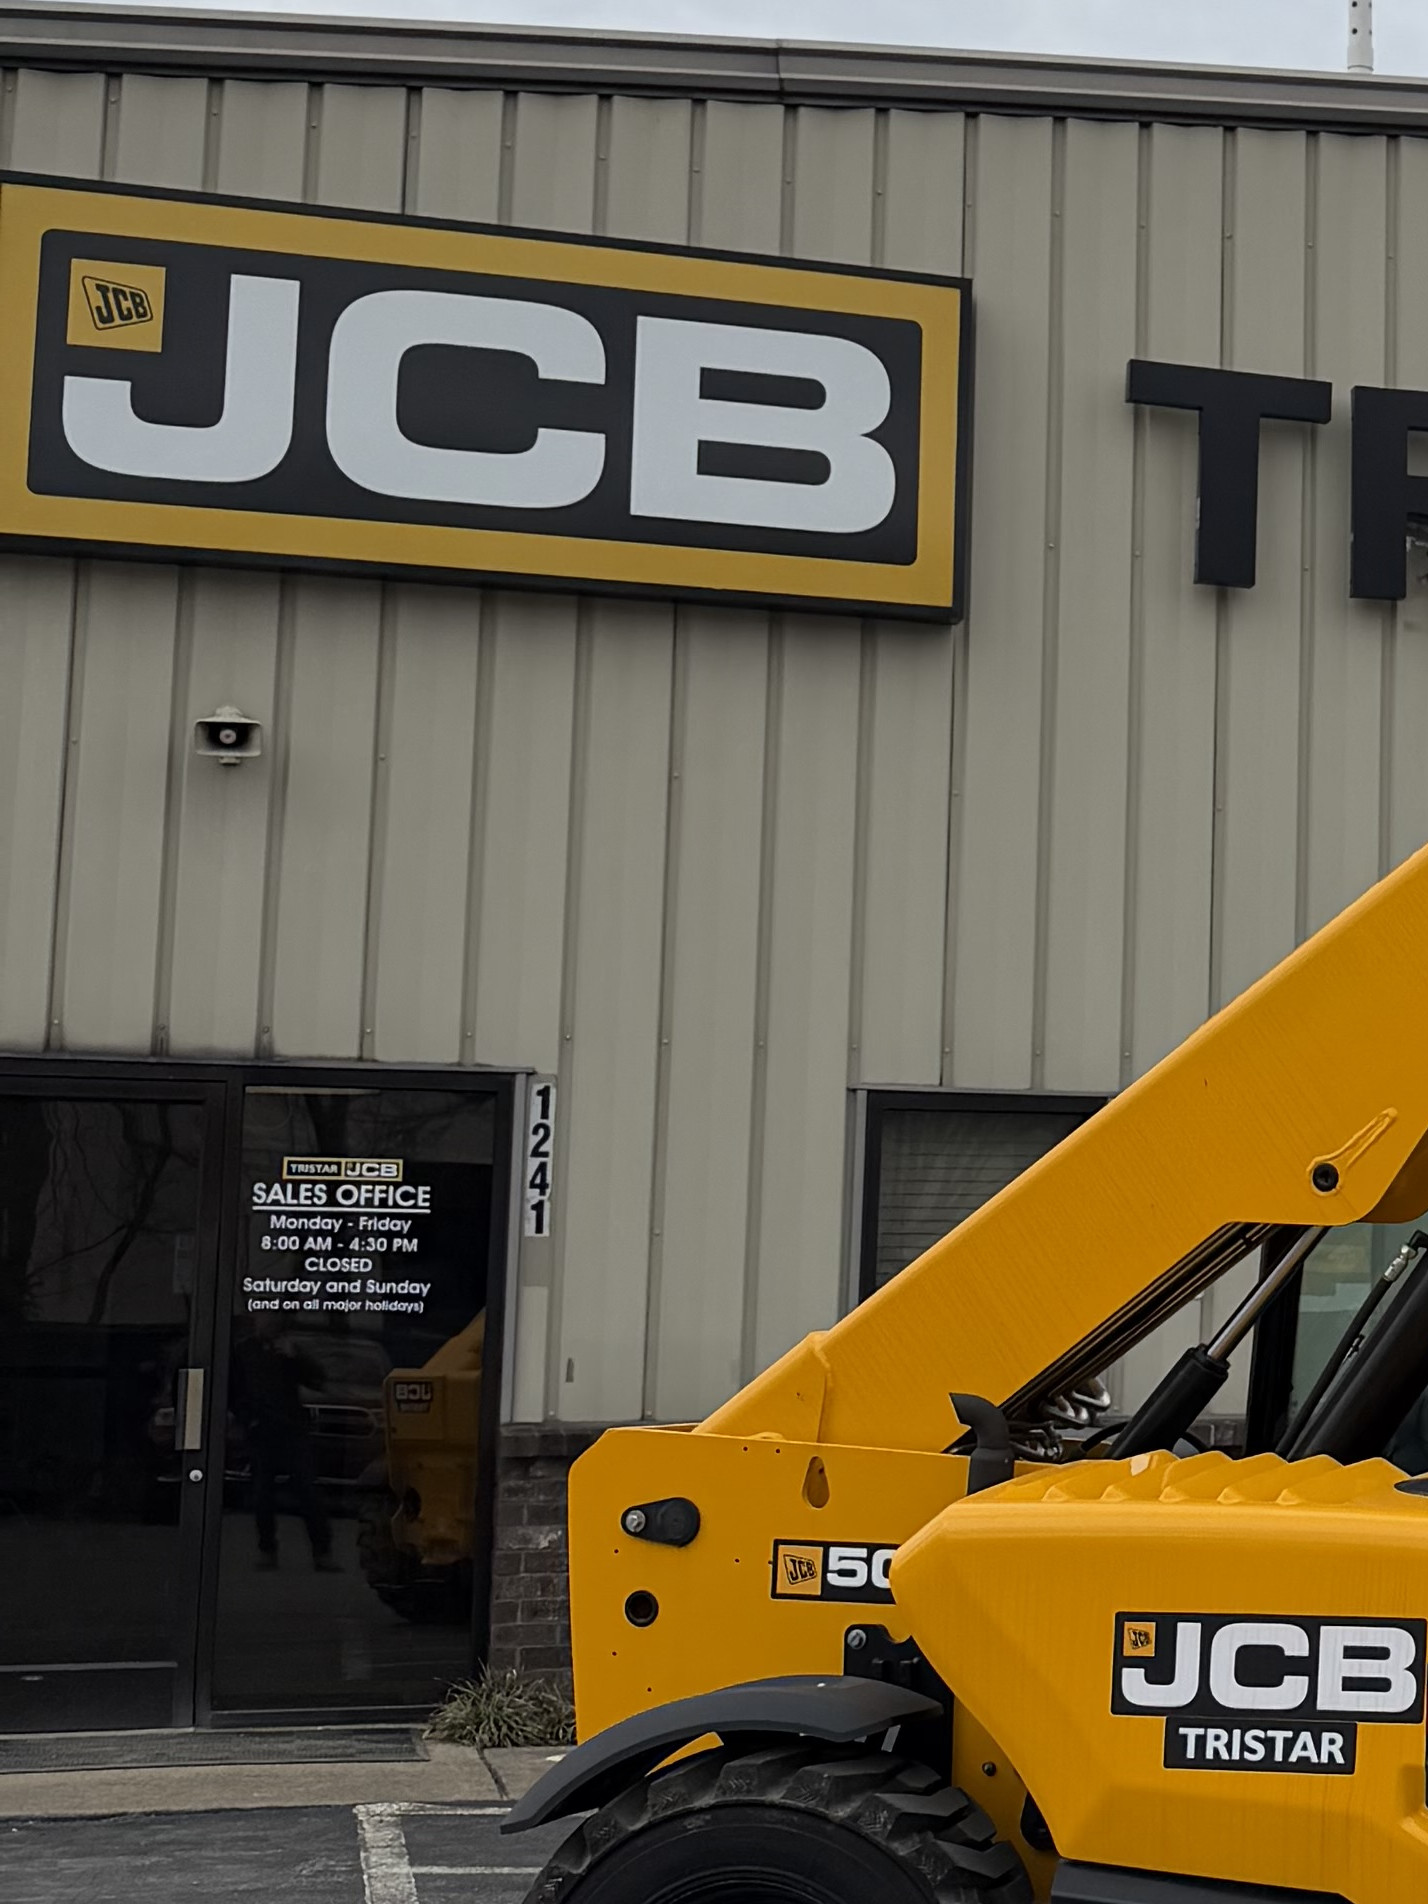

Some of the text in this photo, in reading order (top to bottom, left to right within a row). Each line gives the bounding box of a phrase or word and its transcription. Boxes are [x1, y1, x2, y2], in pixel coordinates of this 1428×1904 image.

[94, 280, 149, 326] JCB
[62, 273, 897, 533] JCB
[290, 1162, 398, 1177] TRISTAR JCB
[529, 1085, 551, 1235] 1241
[252, 1182, 432, 1207] SALES OFFICE
[269, 1215, 343, 1233] Monday
[358, 1216, 412, 1234] Friday
[261, 1235, 300, 1250] 8:00
[303, 1236, 332, 1251] AM
[348, 1237, 387, 1252] 4:30
[392, 1238, 418, 1252] PM
[304, 1257, 373, 1272] CLOSED
[243, 1277, 431, 1297] Saturday and Sunday
[248, 1299, 424, 1313] (and on all major holidays)
[789, 1558, 815, 1581] JCB
[1121, 1622, 1417, 1713] JCB
[1178, 1727, 1345, 1764] TRISTAR
